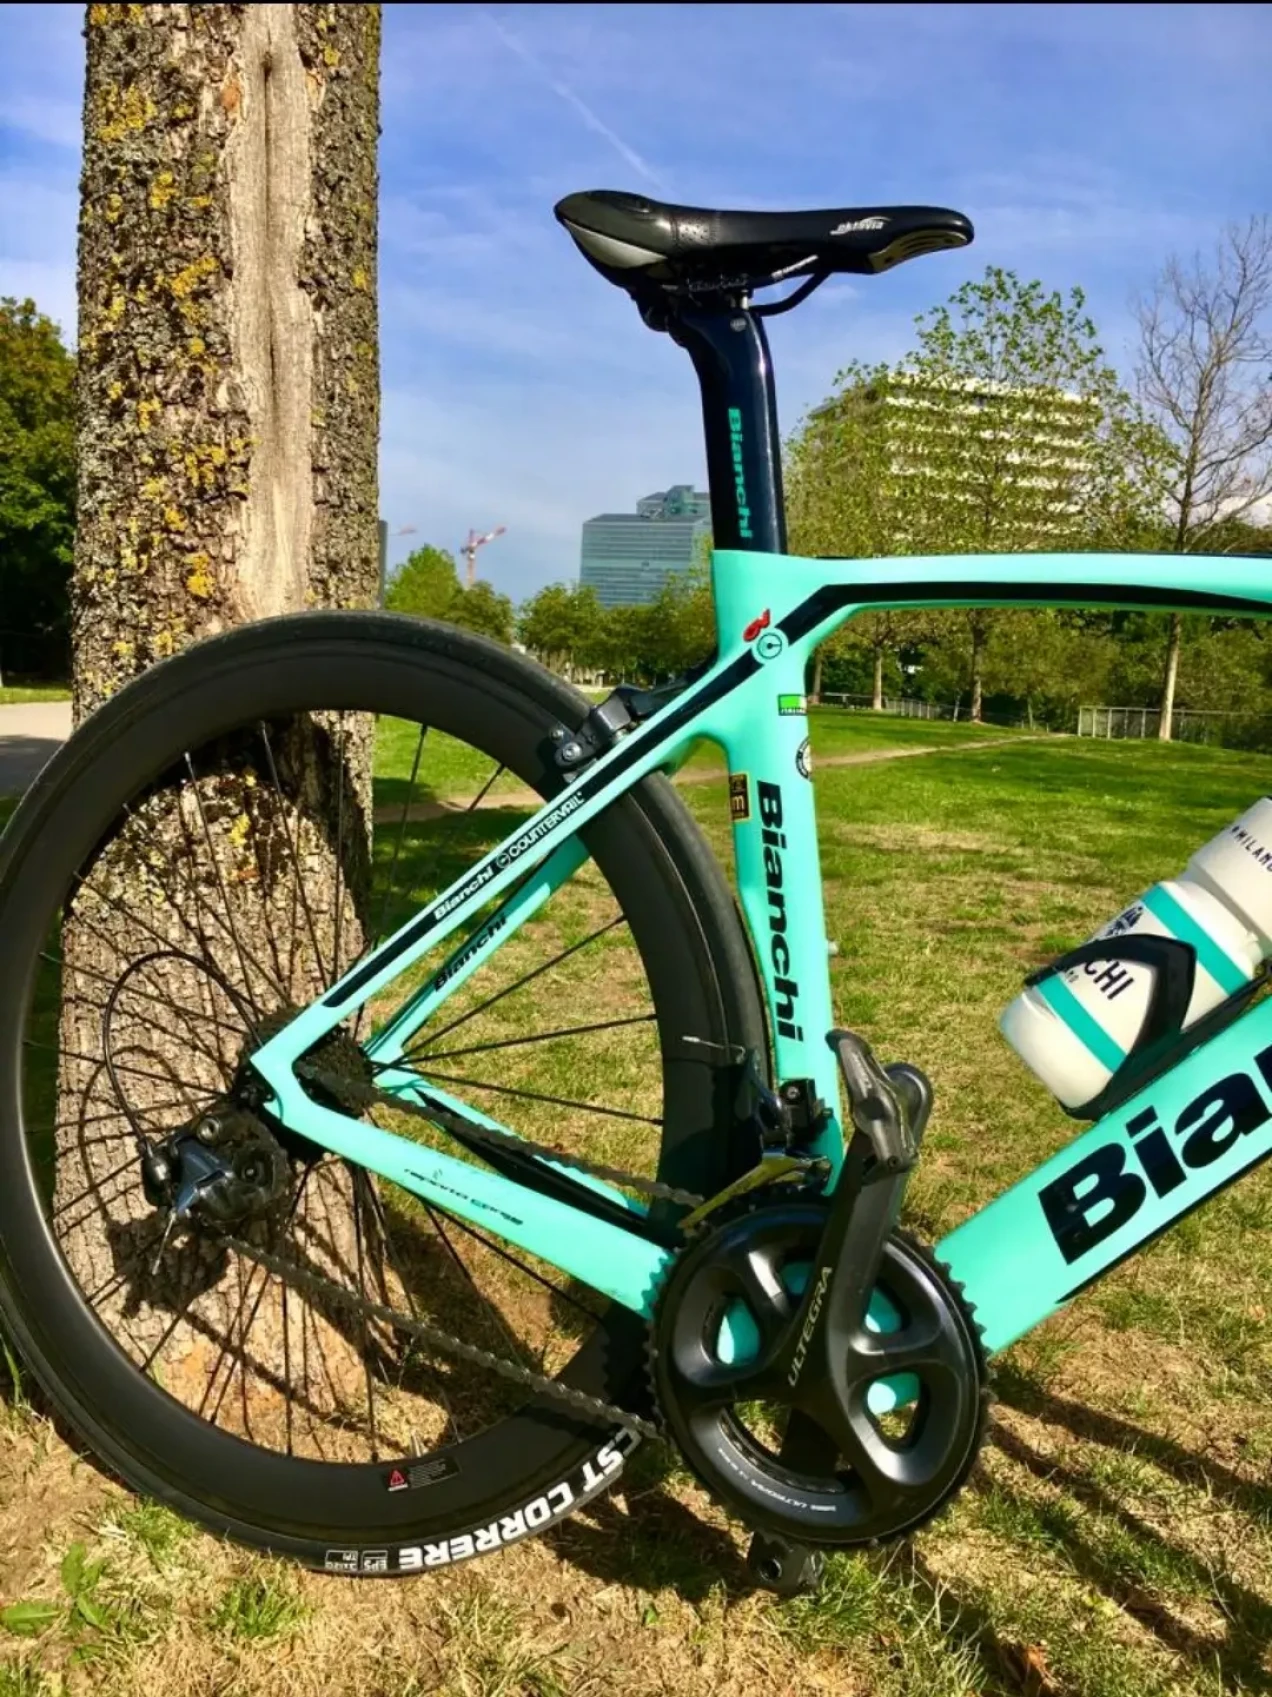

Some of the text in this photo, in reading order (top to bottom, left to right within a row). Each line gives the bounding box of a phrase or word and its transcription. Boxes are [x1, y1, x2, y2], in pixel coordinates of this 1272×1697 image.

[728, 408, 753, 538] Bianchi
[433, 867, 494, 921] Bianchi
[757, 780, 804, 1042] Bianchi
[433, 912, 508, 992] Bianchi
[1084, 958, 1134, 1000] CHI
[788, 1267, 832, 1387] ULTEGRA
[584, 1426, 642, 1492] CST
[399, 1481, 575, 1571] CORRERE
